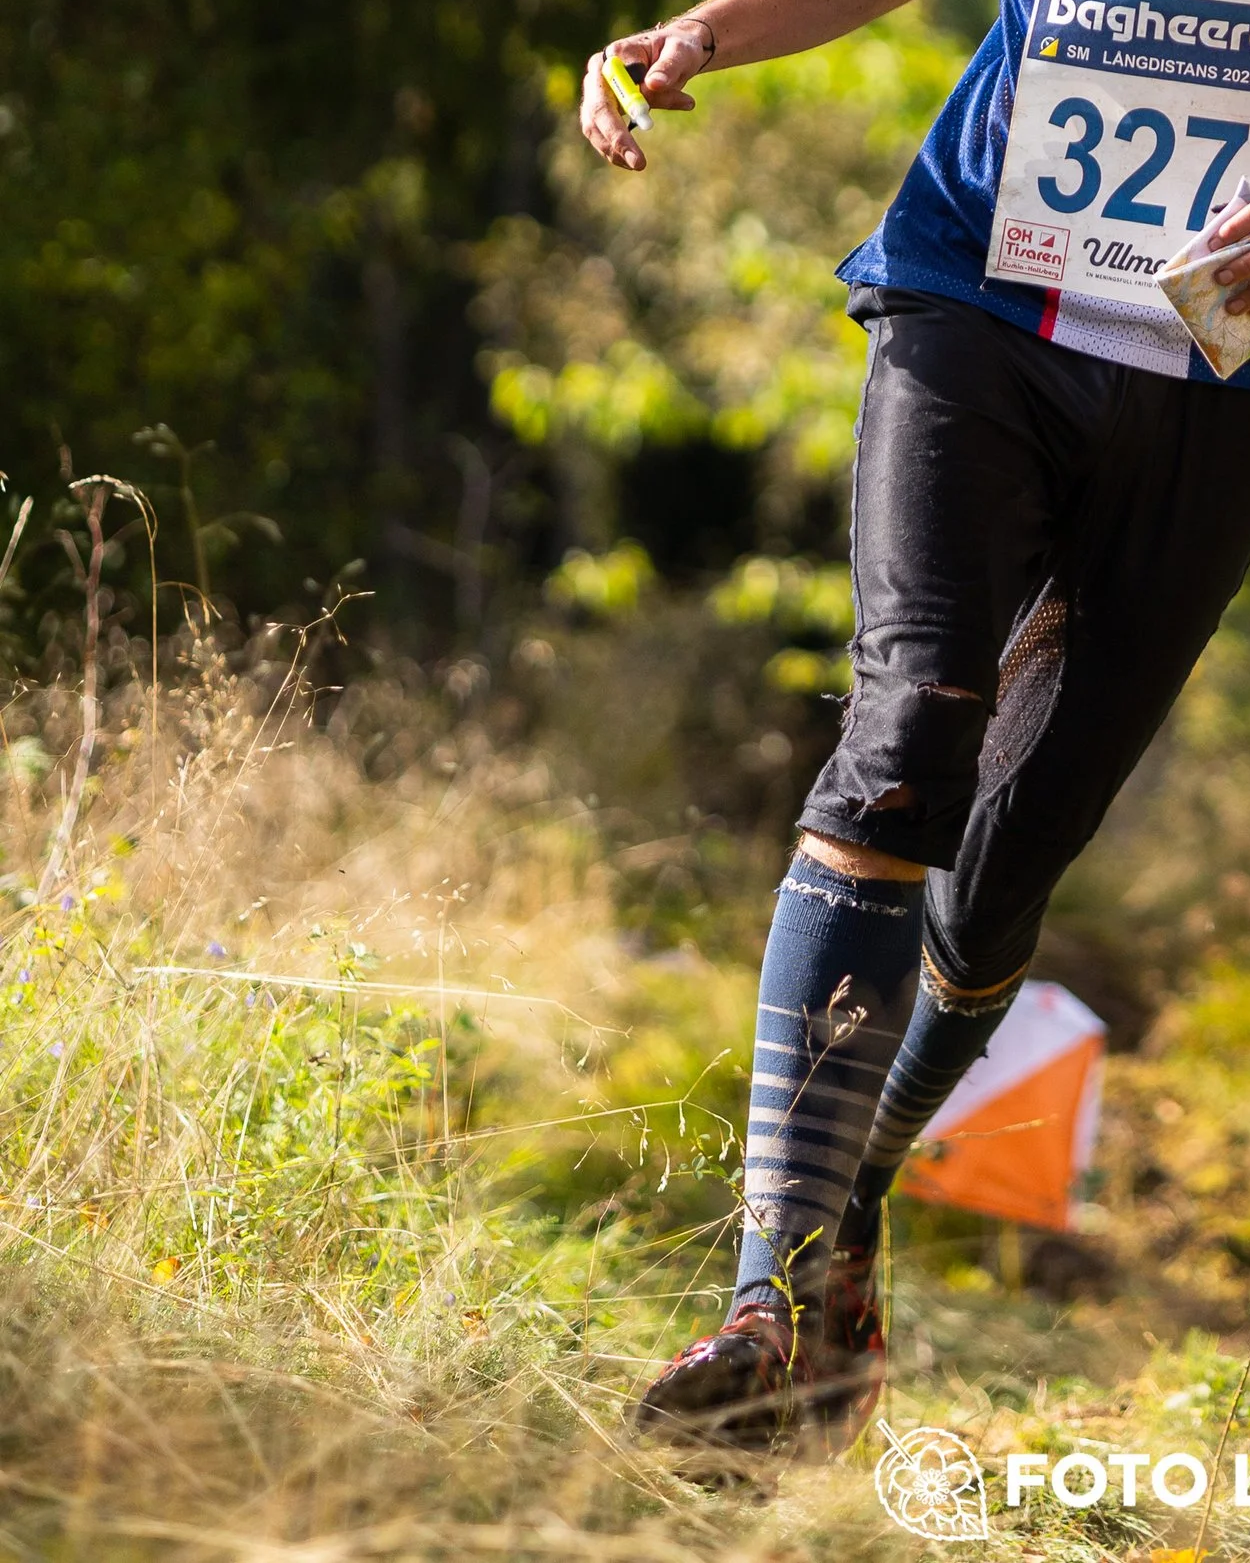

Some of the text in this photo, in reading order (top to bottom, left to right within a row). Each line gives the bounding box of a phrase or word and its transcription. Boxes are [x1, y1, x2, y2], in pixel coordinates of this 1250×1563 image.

[1067, 45, 1090, 61] SM
[1103, 50, 1218, 79] LÅNGDISTANS
[1037, 97, 1250, 231] 327
[1006, 241, 1062, 265] Tisaren
[1083, 238, 1168, 275] Ullm
[1095, 273, 1133, 285] MENINGSFULL
